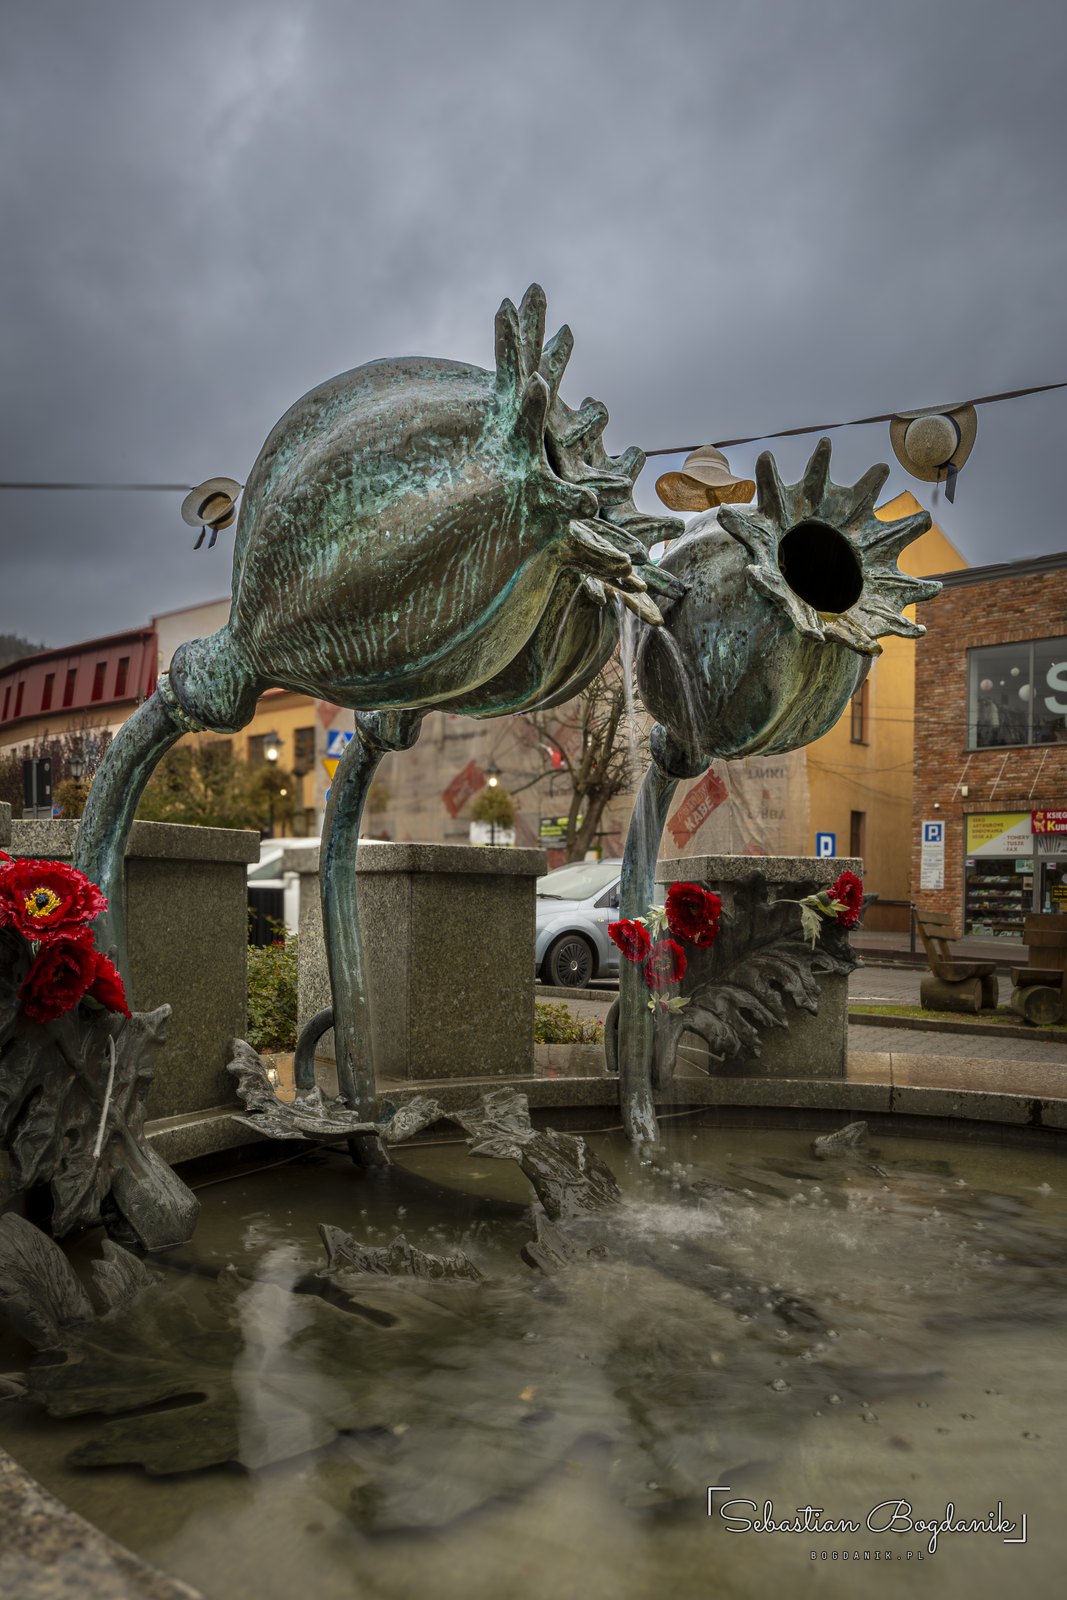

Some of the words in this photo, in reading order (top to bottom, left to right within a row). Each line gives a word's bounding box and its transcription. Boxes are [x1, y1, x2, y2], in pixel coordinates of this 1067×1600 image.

[683, 795, 714, 833] KABE
[928, 825, 939, 840] P
[820, 836, 833, 858] P
